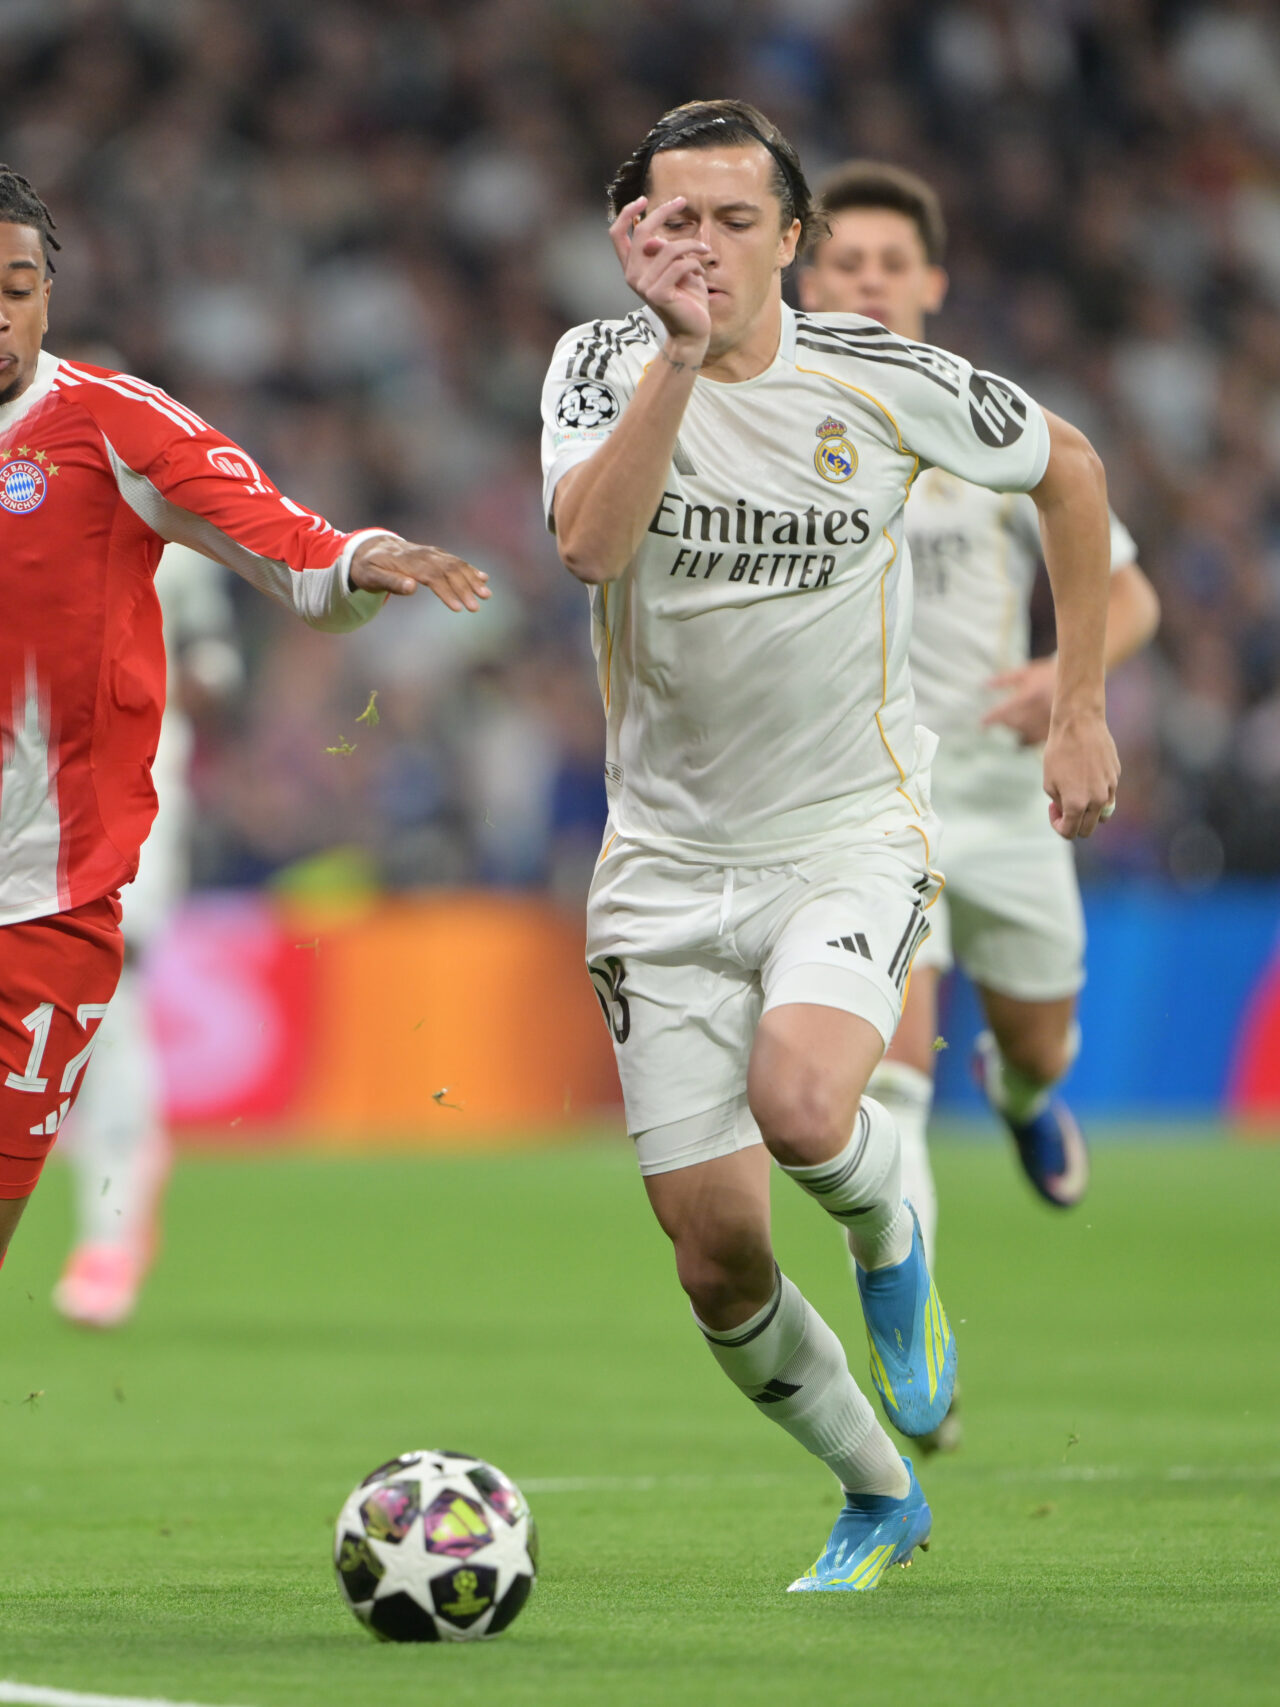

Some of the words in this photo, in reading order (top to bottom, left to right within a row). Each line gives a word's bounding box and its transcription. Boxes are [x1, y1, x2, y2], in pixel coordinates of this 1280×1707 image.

[0, 470, 10, 483] FC
[10, 463, 43, 485] BAYERN
[648, 490, 870, 546] Emirates
[669, 548, 724, 580] FLY
[728, 552, 837, 589] BETTER
